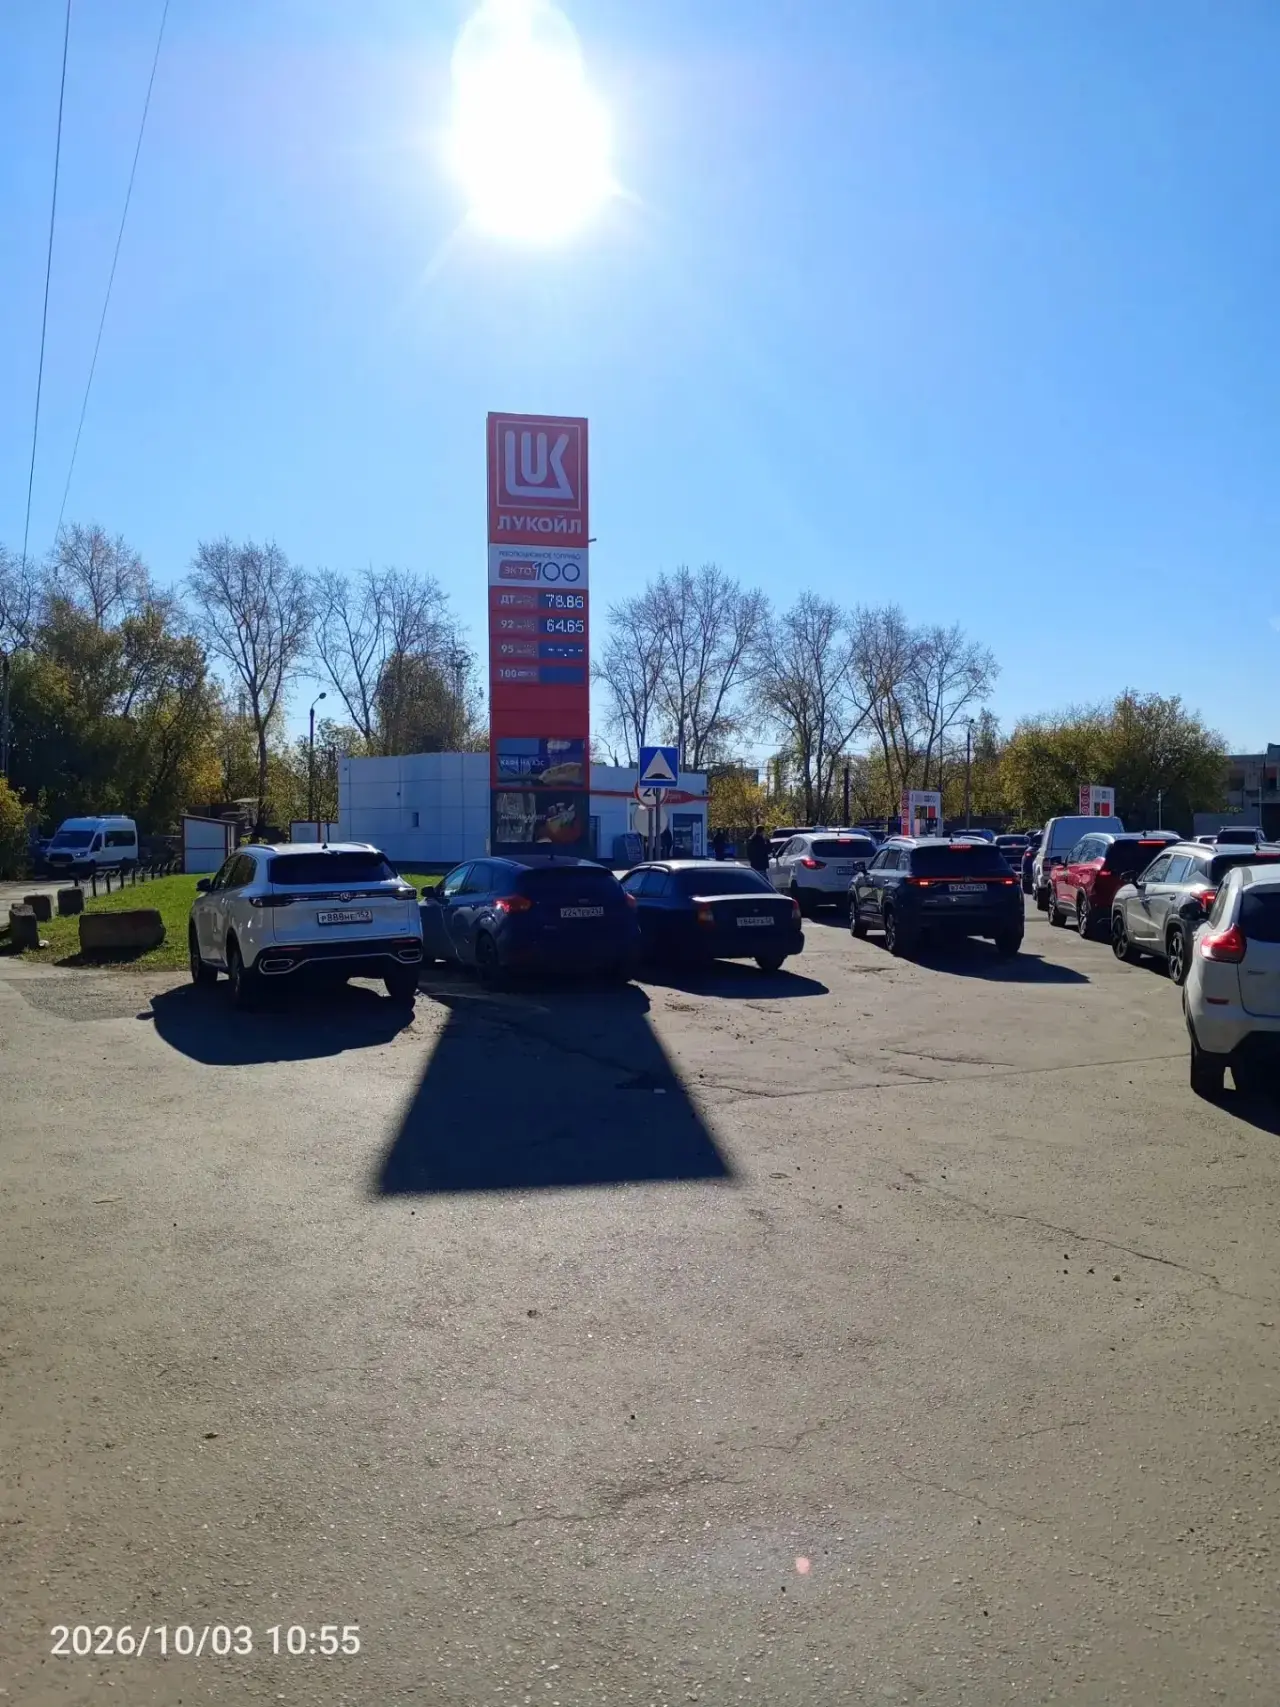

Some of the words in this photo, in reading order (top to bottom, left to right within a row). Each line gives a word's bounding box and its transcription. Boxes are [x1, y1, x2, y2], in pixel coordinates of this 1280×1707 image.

[497, 514, 581, 534] ЛУКОЙЛ
[533, 561, 580, 582] 100
[501, 594, 515, 605] ДТ
[545, 593, 584, 609] 78.86
[501, 619, 515, 629] 92
[546, 618, 584, 633] 64.65
[501, 644, 514, 654] 95
[500, 669, 517, 678] 100
